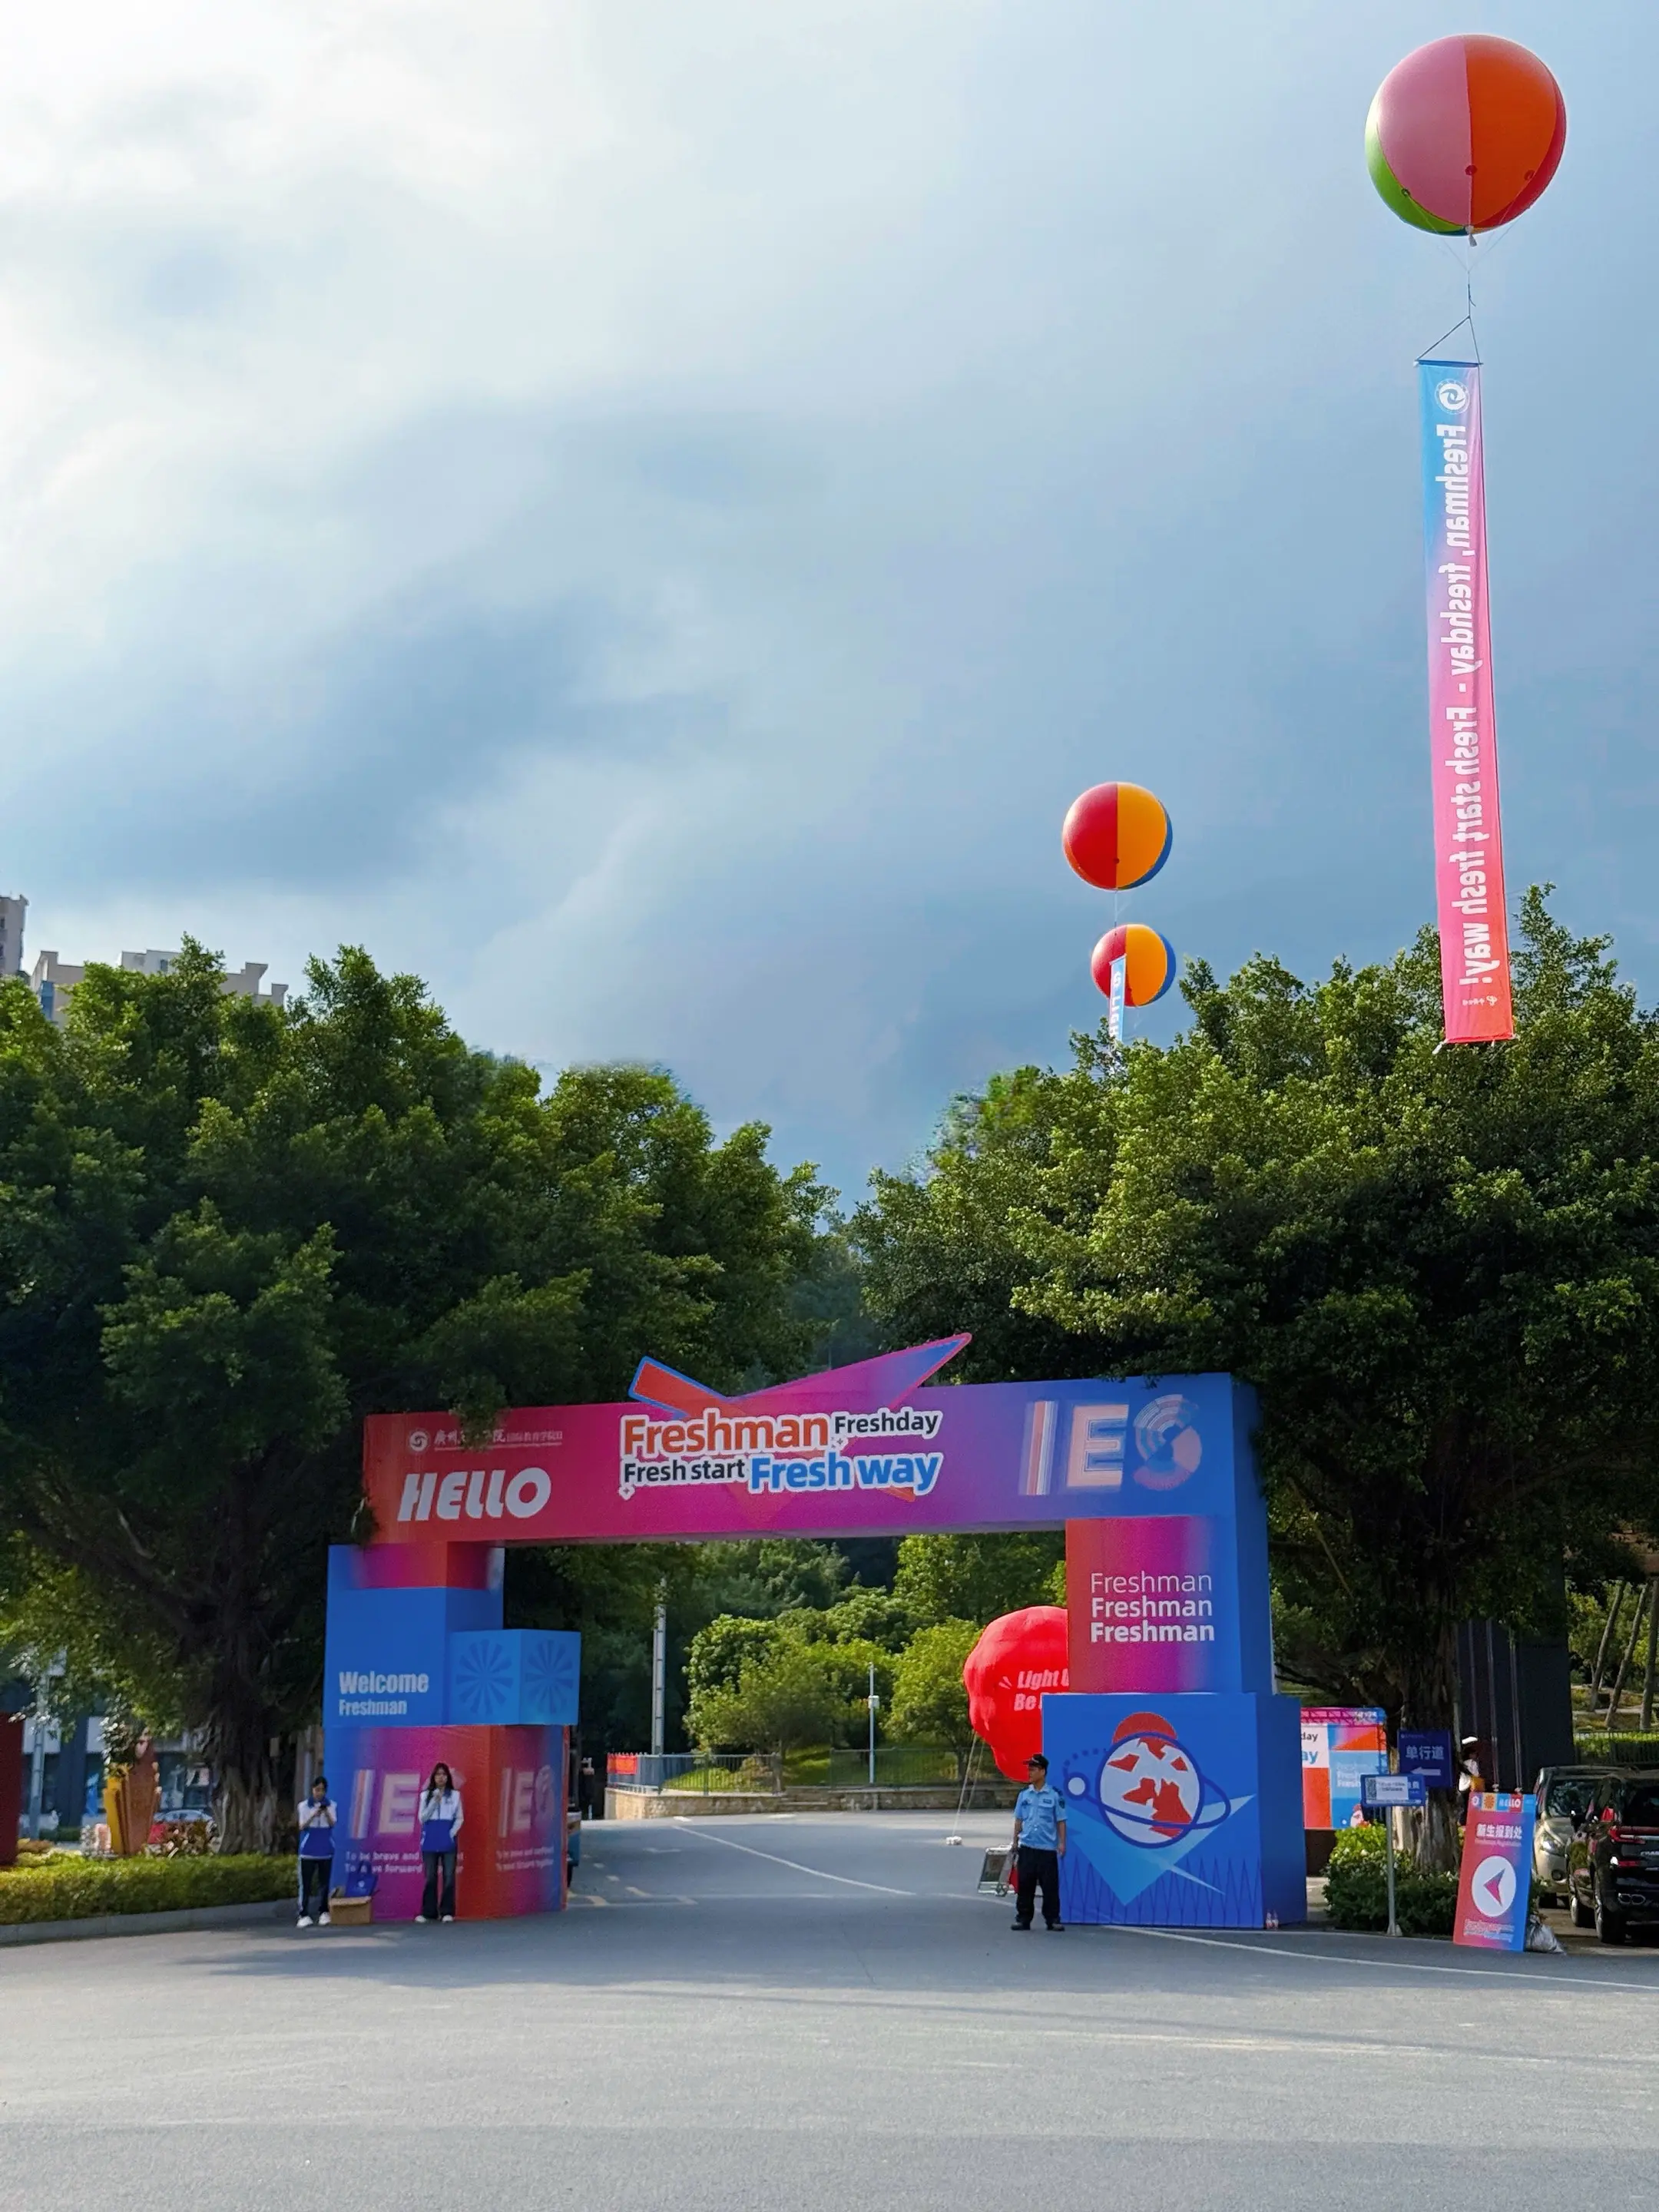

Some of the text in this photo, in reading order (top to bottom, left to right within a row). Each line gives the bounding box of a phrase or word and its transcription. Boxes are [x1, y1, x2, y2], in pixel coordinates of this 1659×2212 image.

[623, 1410, 939, 1455] Freshman Freshday
[624, 1452, 939, 1492] Fresh start Fresh way
[397, 1467, 551, 1522] HELLO
[1091, 1570, 1212, 1594] Freshman
[1092, 1595, 1213, 1618] Freshman
[1091, 1620, 1215, 1643] Freshman
[339, 1671, 429, 1694] Welcome
[1017, 1669, 1059, 1690] Light
[339, 1699, 408, 1717] Freshman
[1014, 1693, 1037, 1711] Be
[1406, 1745, 1445, 1760] 单行道
[1476, 1823, 1523, 1839] 新生报到处
